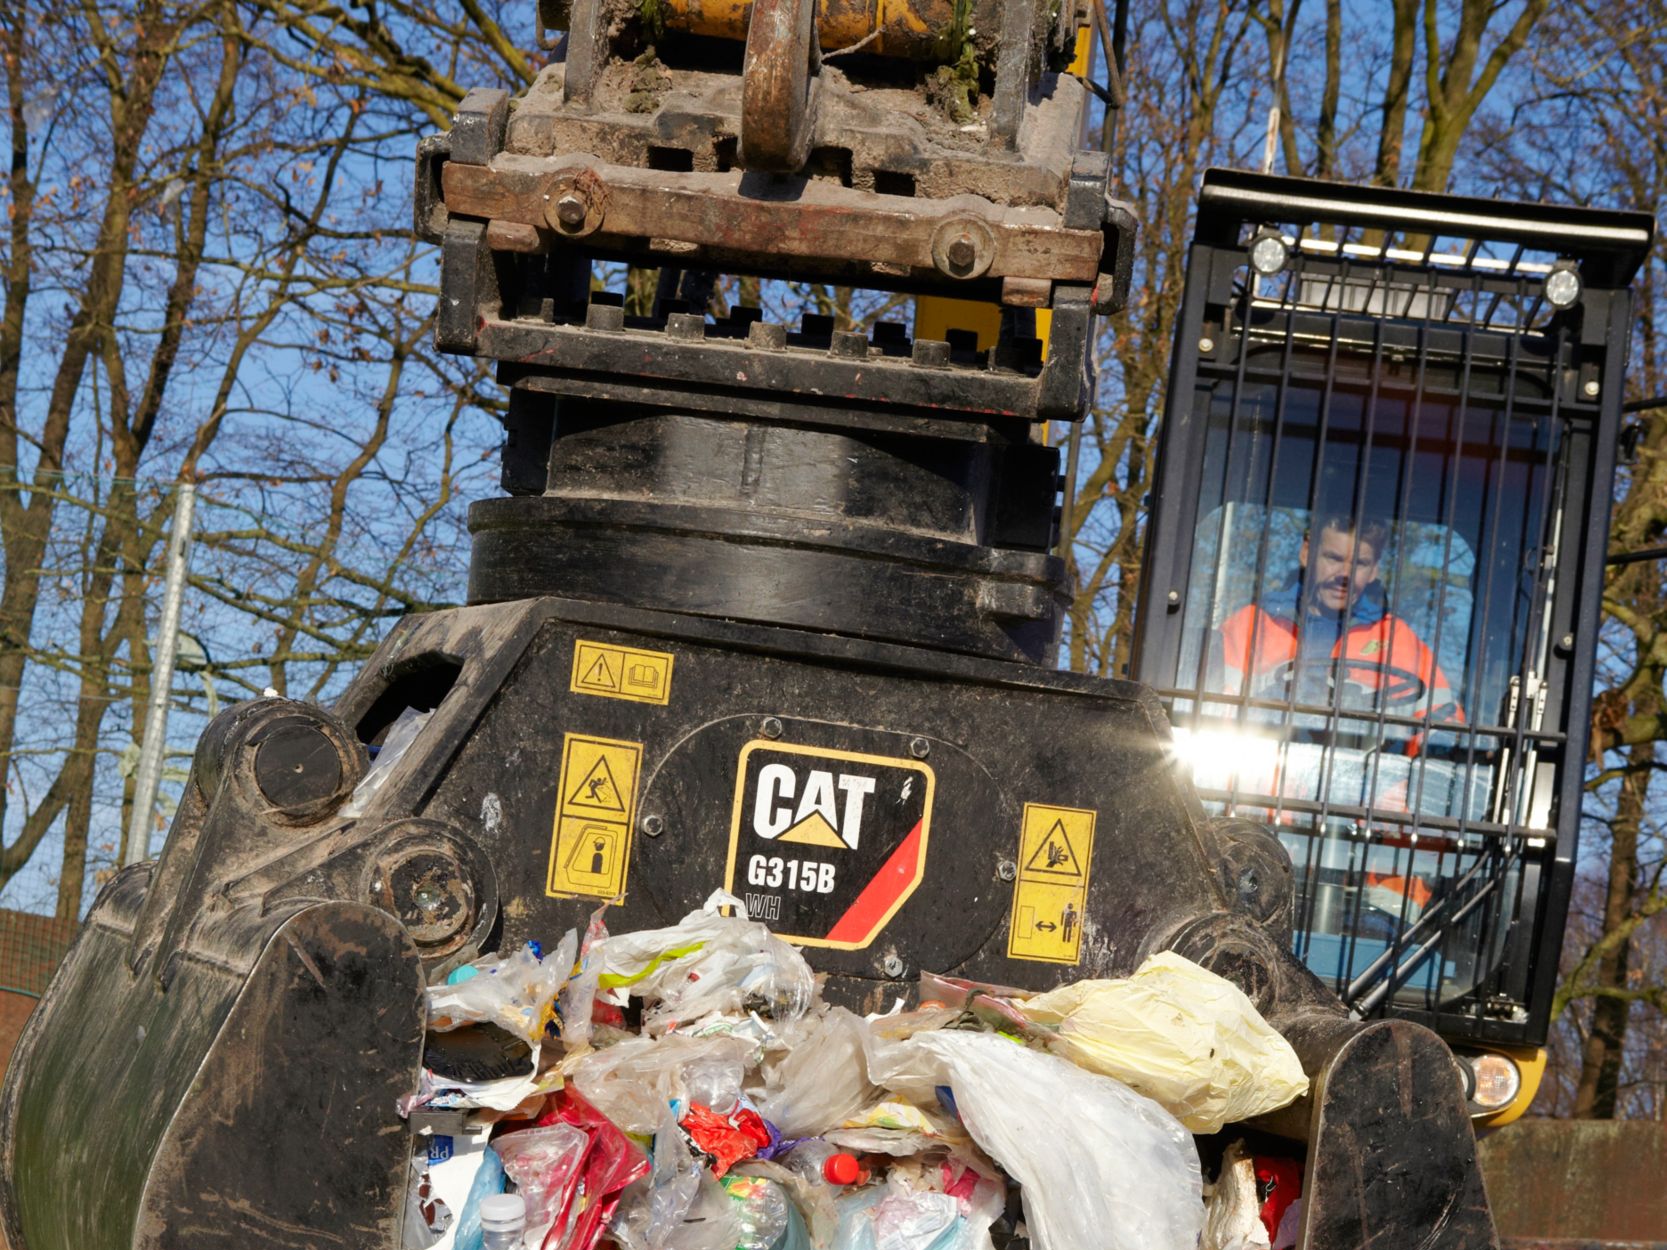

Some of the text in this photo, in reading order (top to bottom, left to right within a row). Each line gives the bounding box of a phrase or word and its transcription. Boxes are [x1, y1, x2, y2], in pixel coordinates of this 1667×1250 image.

[753, 763, 876, 850] CAT
[748, 854, 836, 894] G315B
[745, 892, 782, 920] WH
